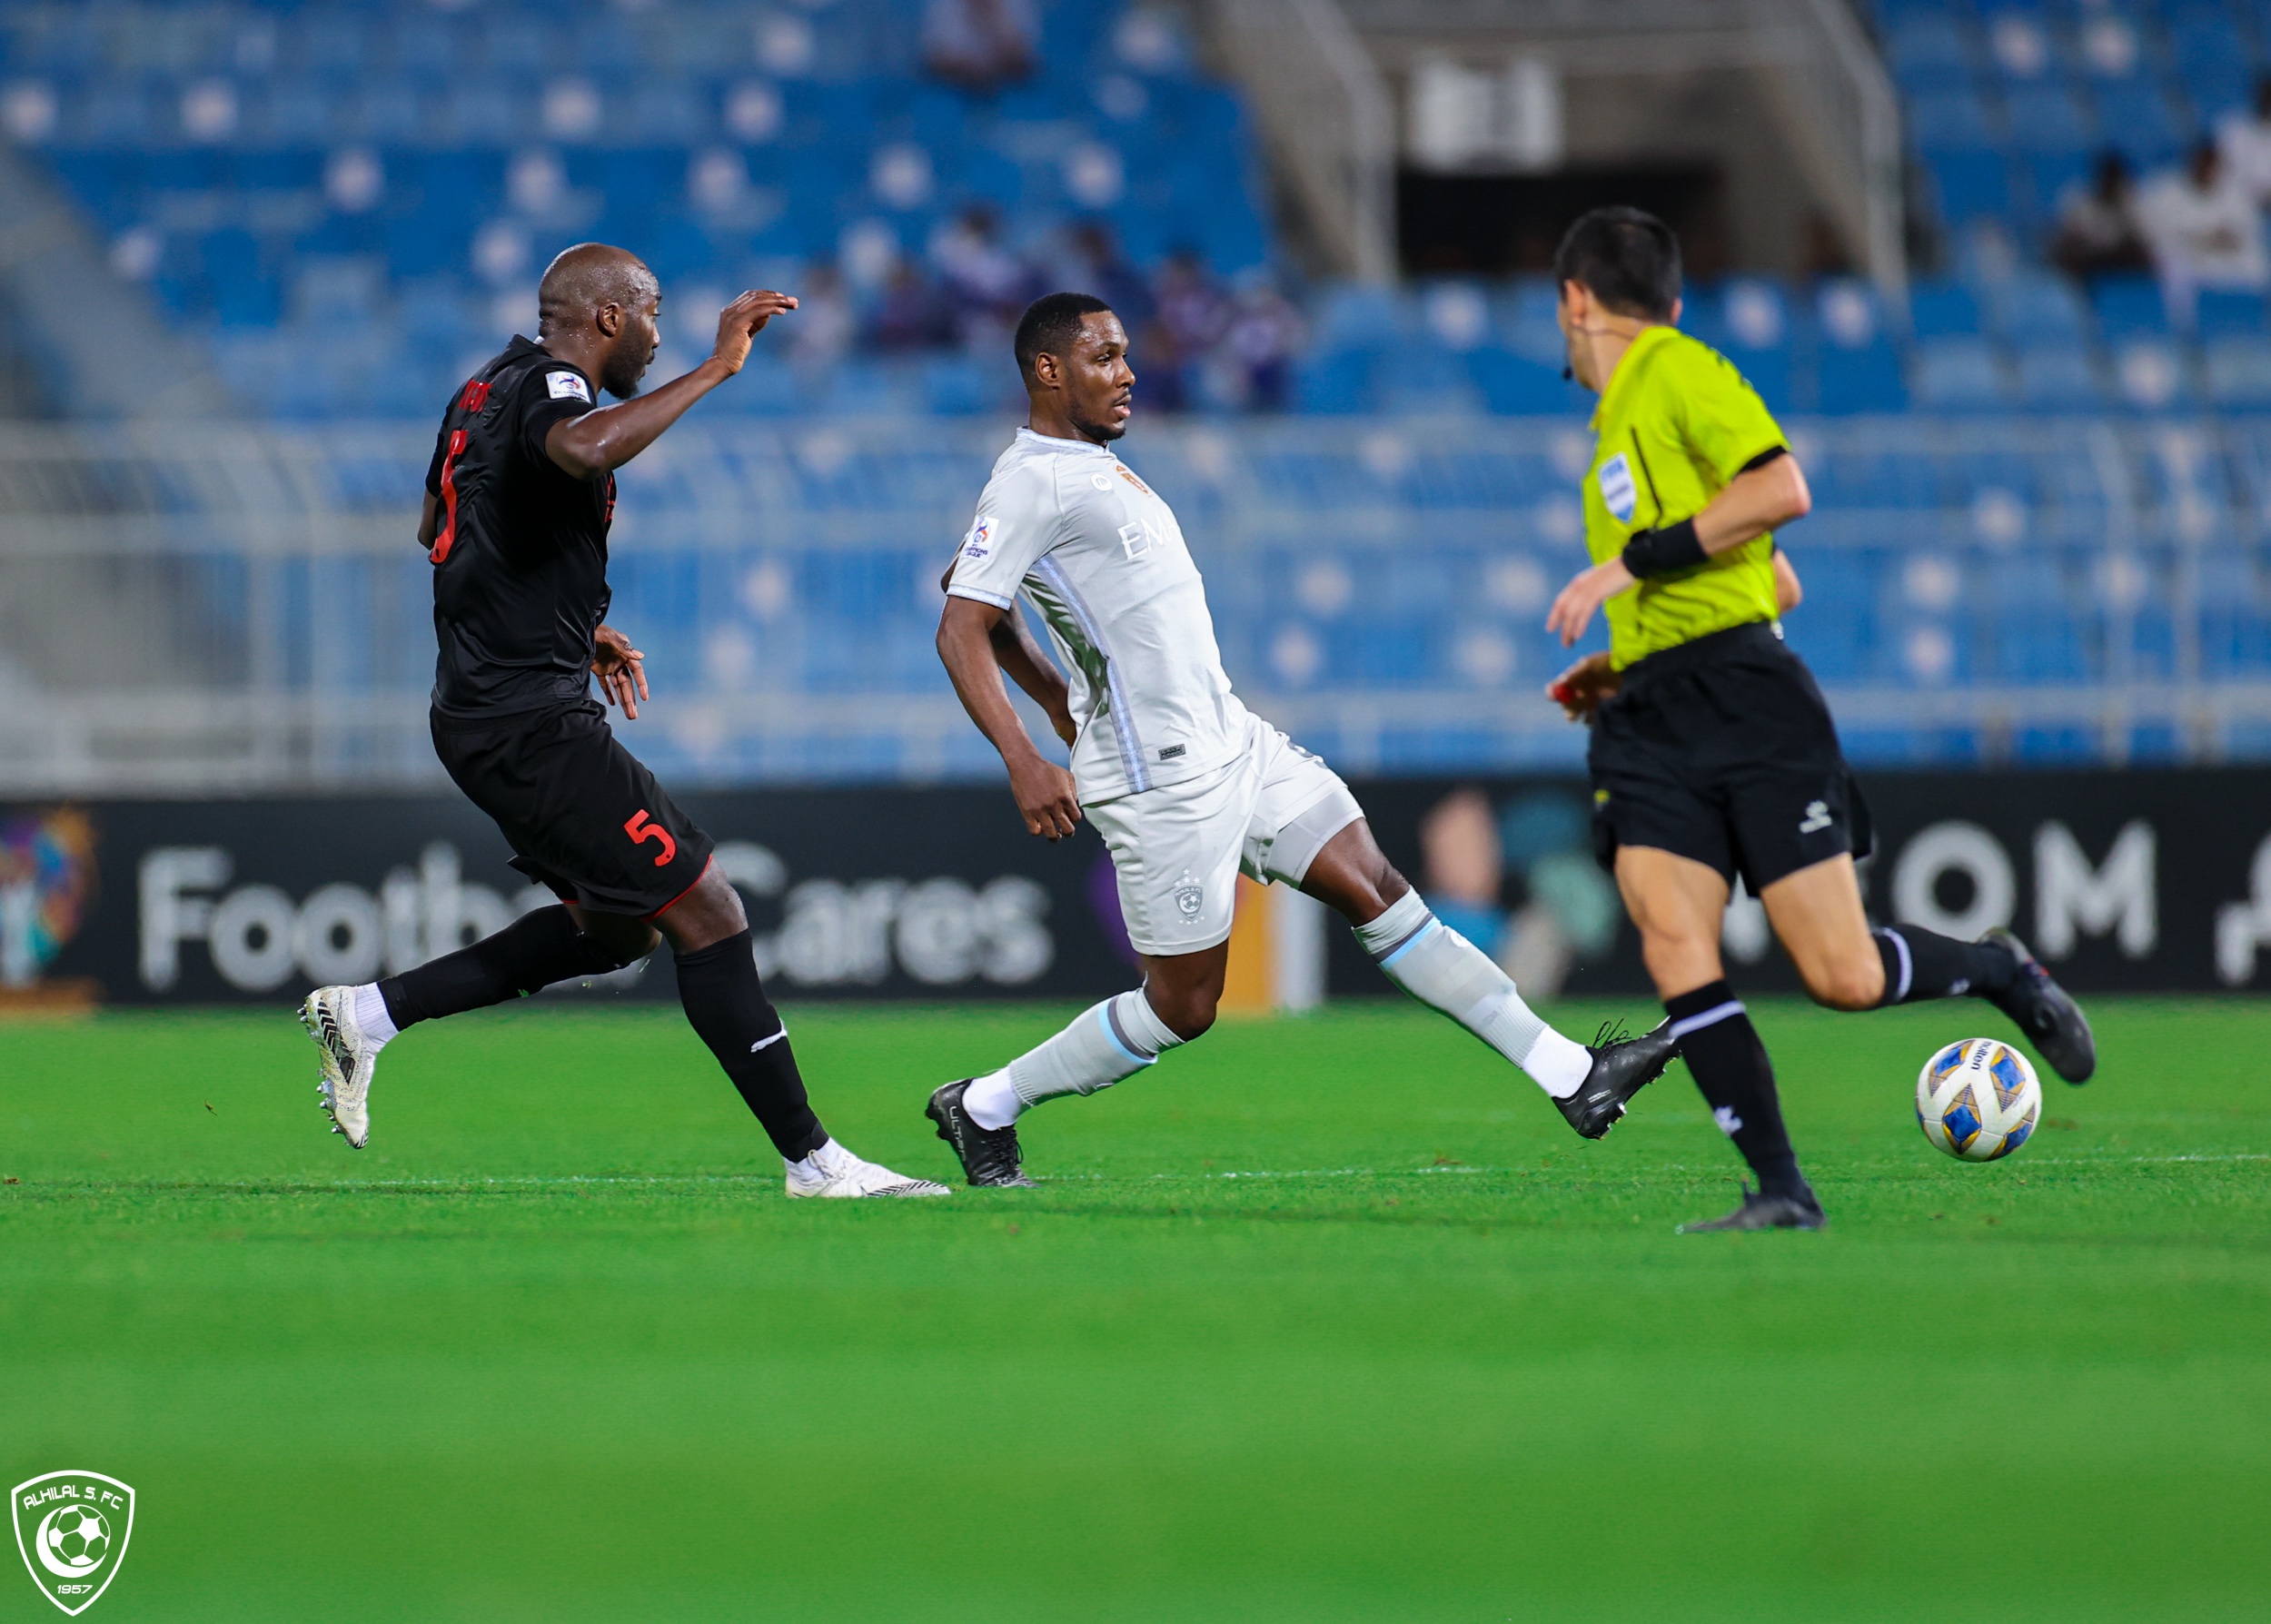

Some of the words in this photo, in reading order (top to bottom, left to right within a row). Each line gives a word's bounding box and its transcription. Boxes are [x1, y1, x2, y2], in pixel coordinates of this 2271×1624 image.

[623, 808, 677, 866] 5
[137, 837, 649, 992] Footb
[1970, 1041, 1993, 1070] molten
